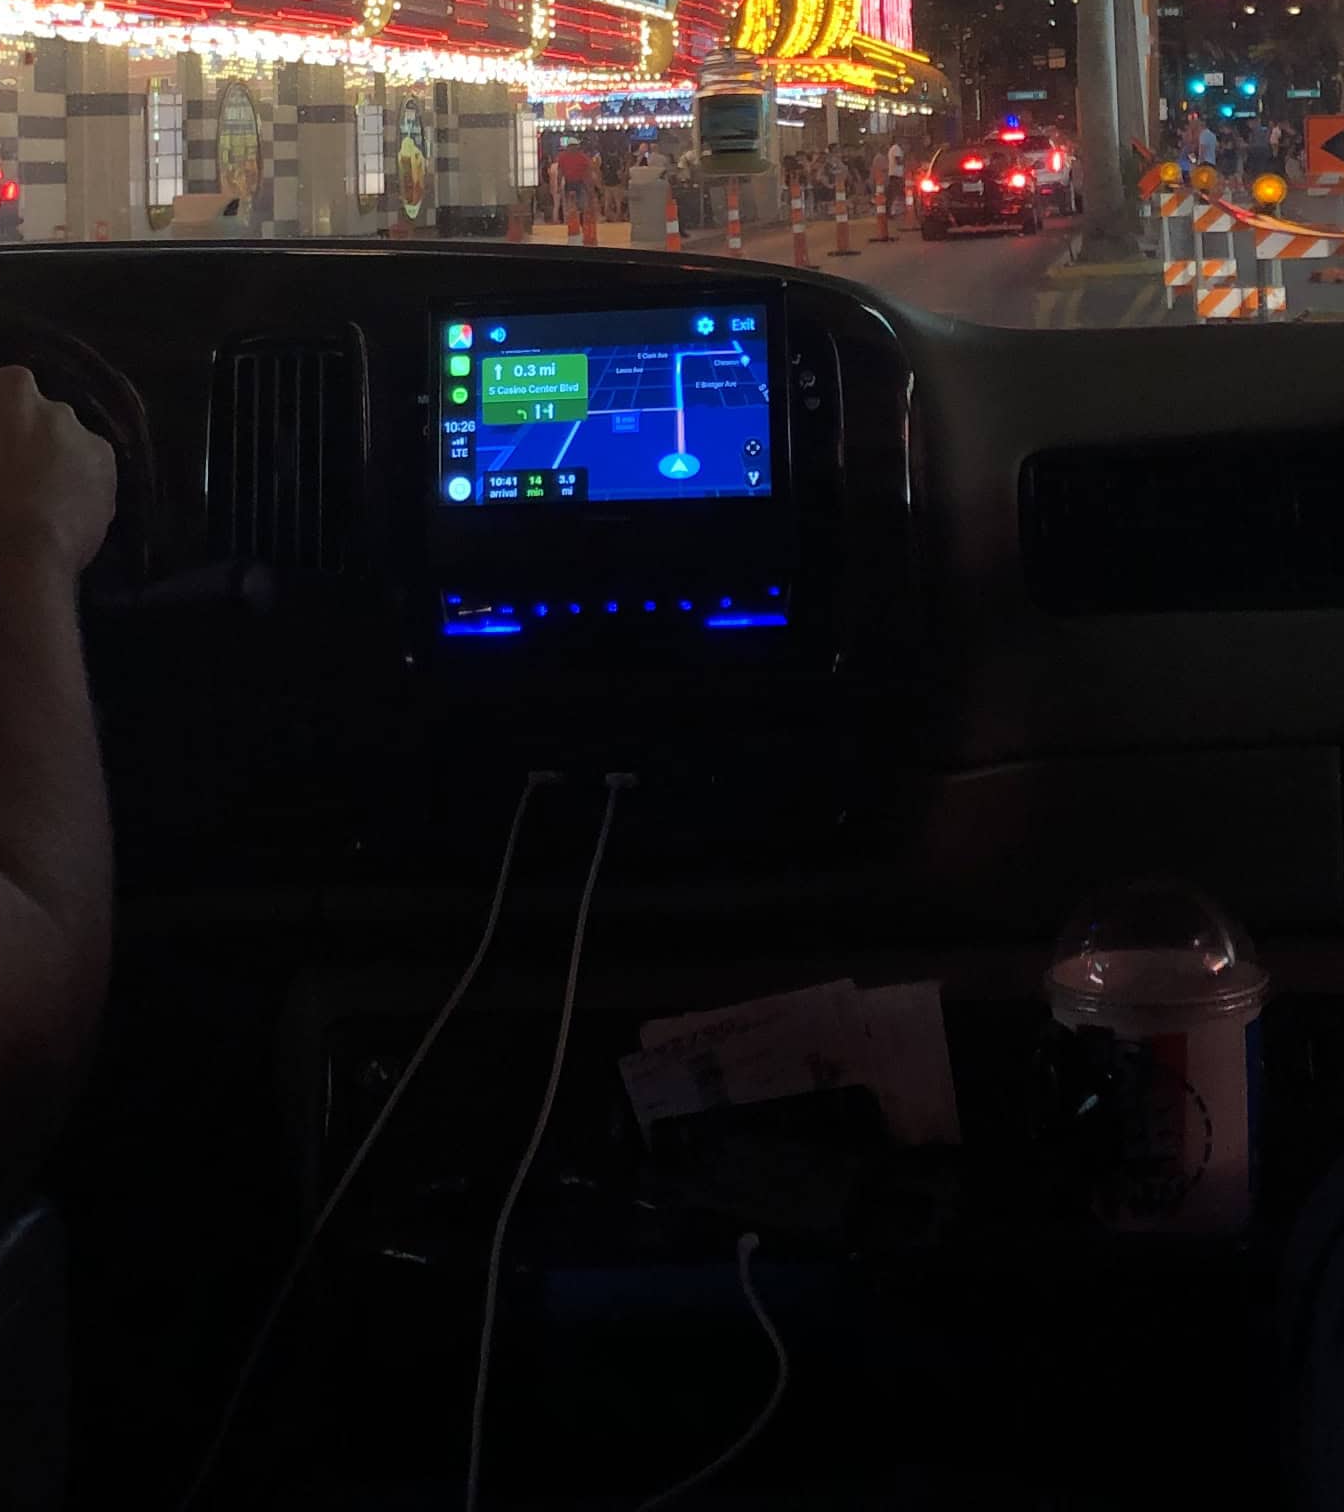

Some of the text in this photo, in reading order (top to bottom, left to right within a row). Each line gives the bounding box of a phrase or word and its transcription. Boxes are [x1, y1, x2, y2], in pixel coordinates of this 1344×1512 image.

[732, 317, 755, 331] Exit
[514, 362, 556, 377] 0.3 mi
[488, 383, 579, 395] S Casino Center Blvd
[444, 421, 476, 433] 10:26
[451, 448, 468, 458] LTE
[489, 474, 576, 486] 10:41 14 3.9
[489, 486, 573, 498] arrival min mi
